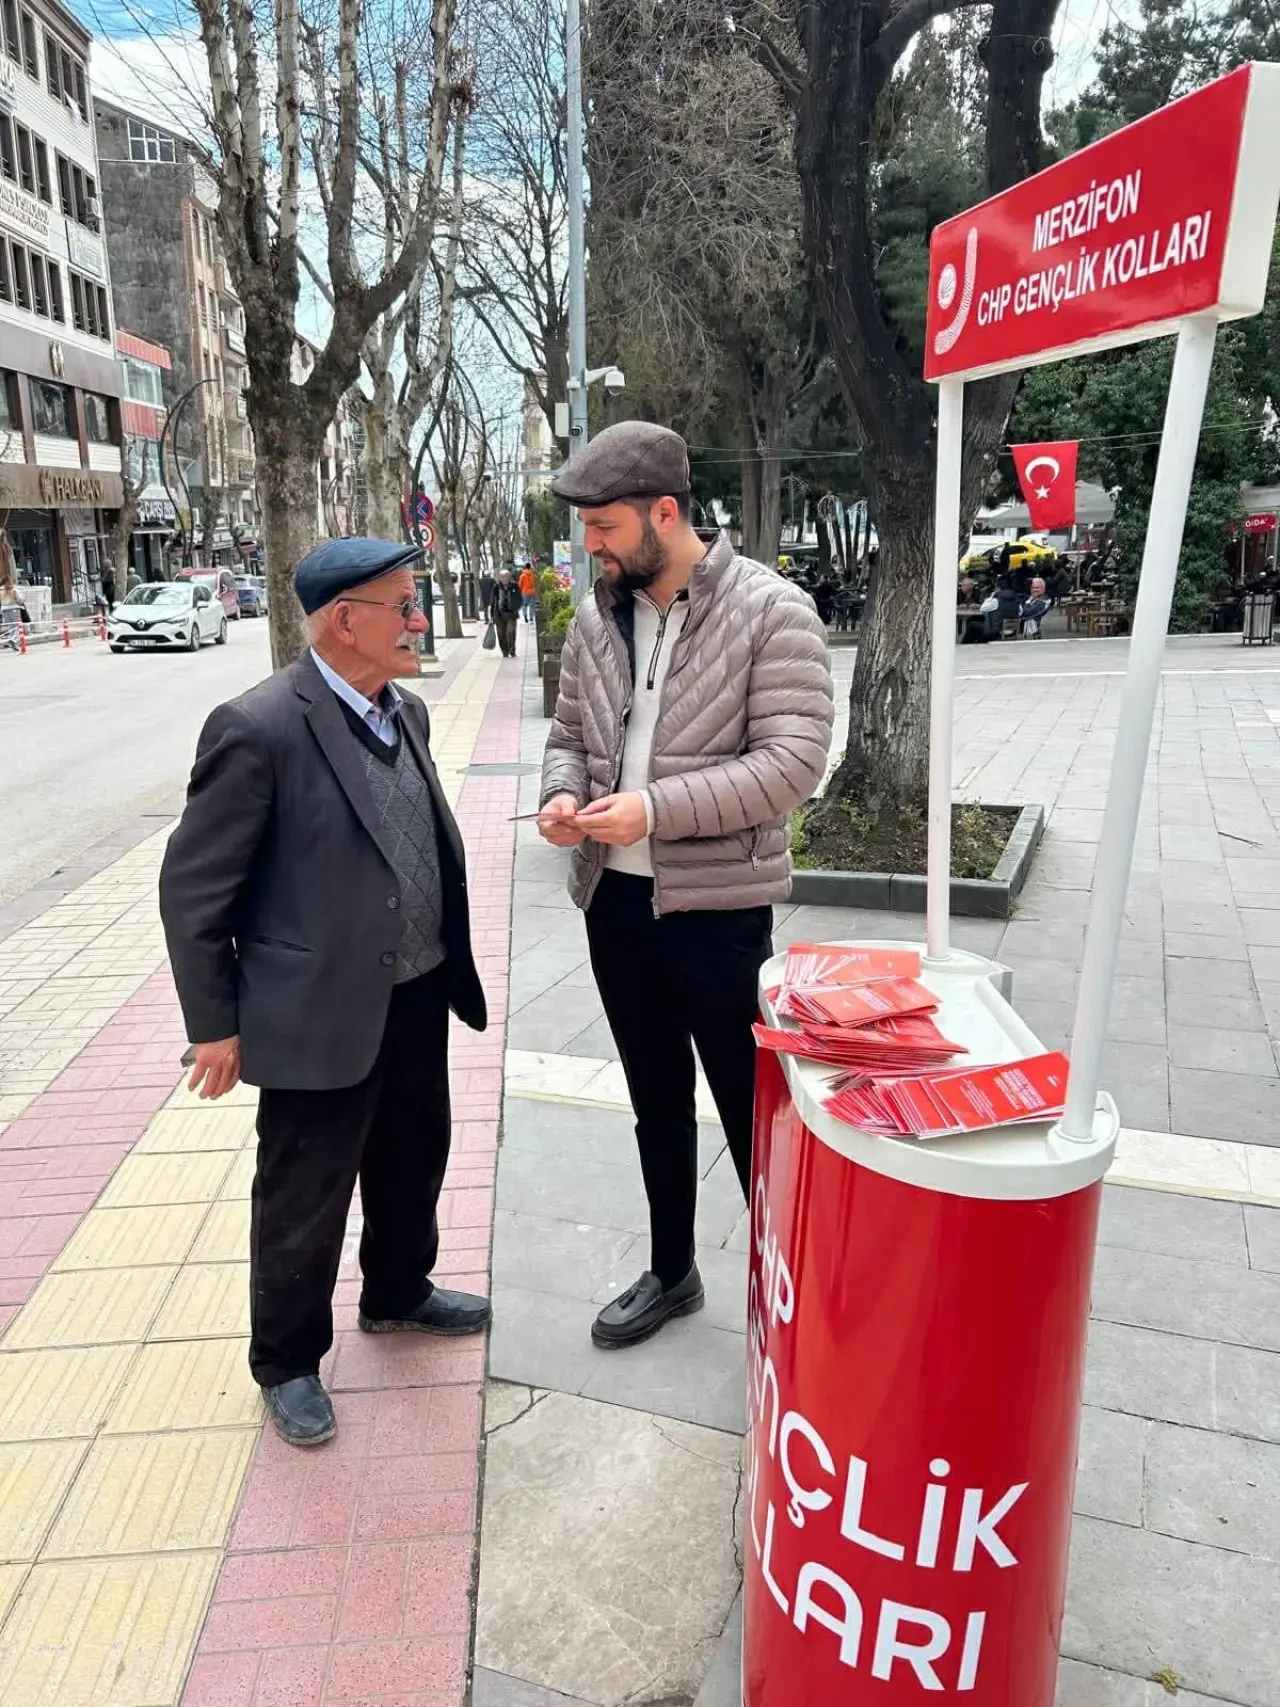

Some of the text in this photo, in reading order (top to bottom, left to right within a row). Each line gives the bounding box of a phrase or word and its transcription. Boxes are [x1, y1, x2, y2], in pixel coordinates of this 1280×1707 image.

[977, 210, 1212, 327] CHP GENÇLİK KOLLARI
[1033, 169, 1141, 253] MERZİFON
[755, 1174, 795, 1329] CHP
